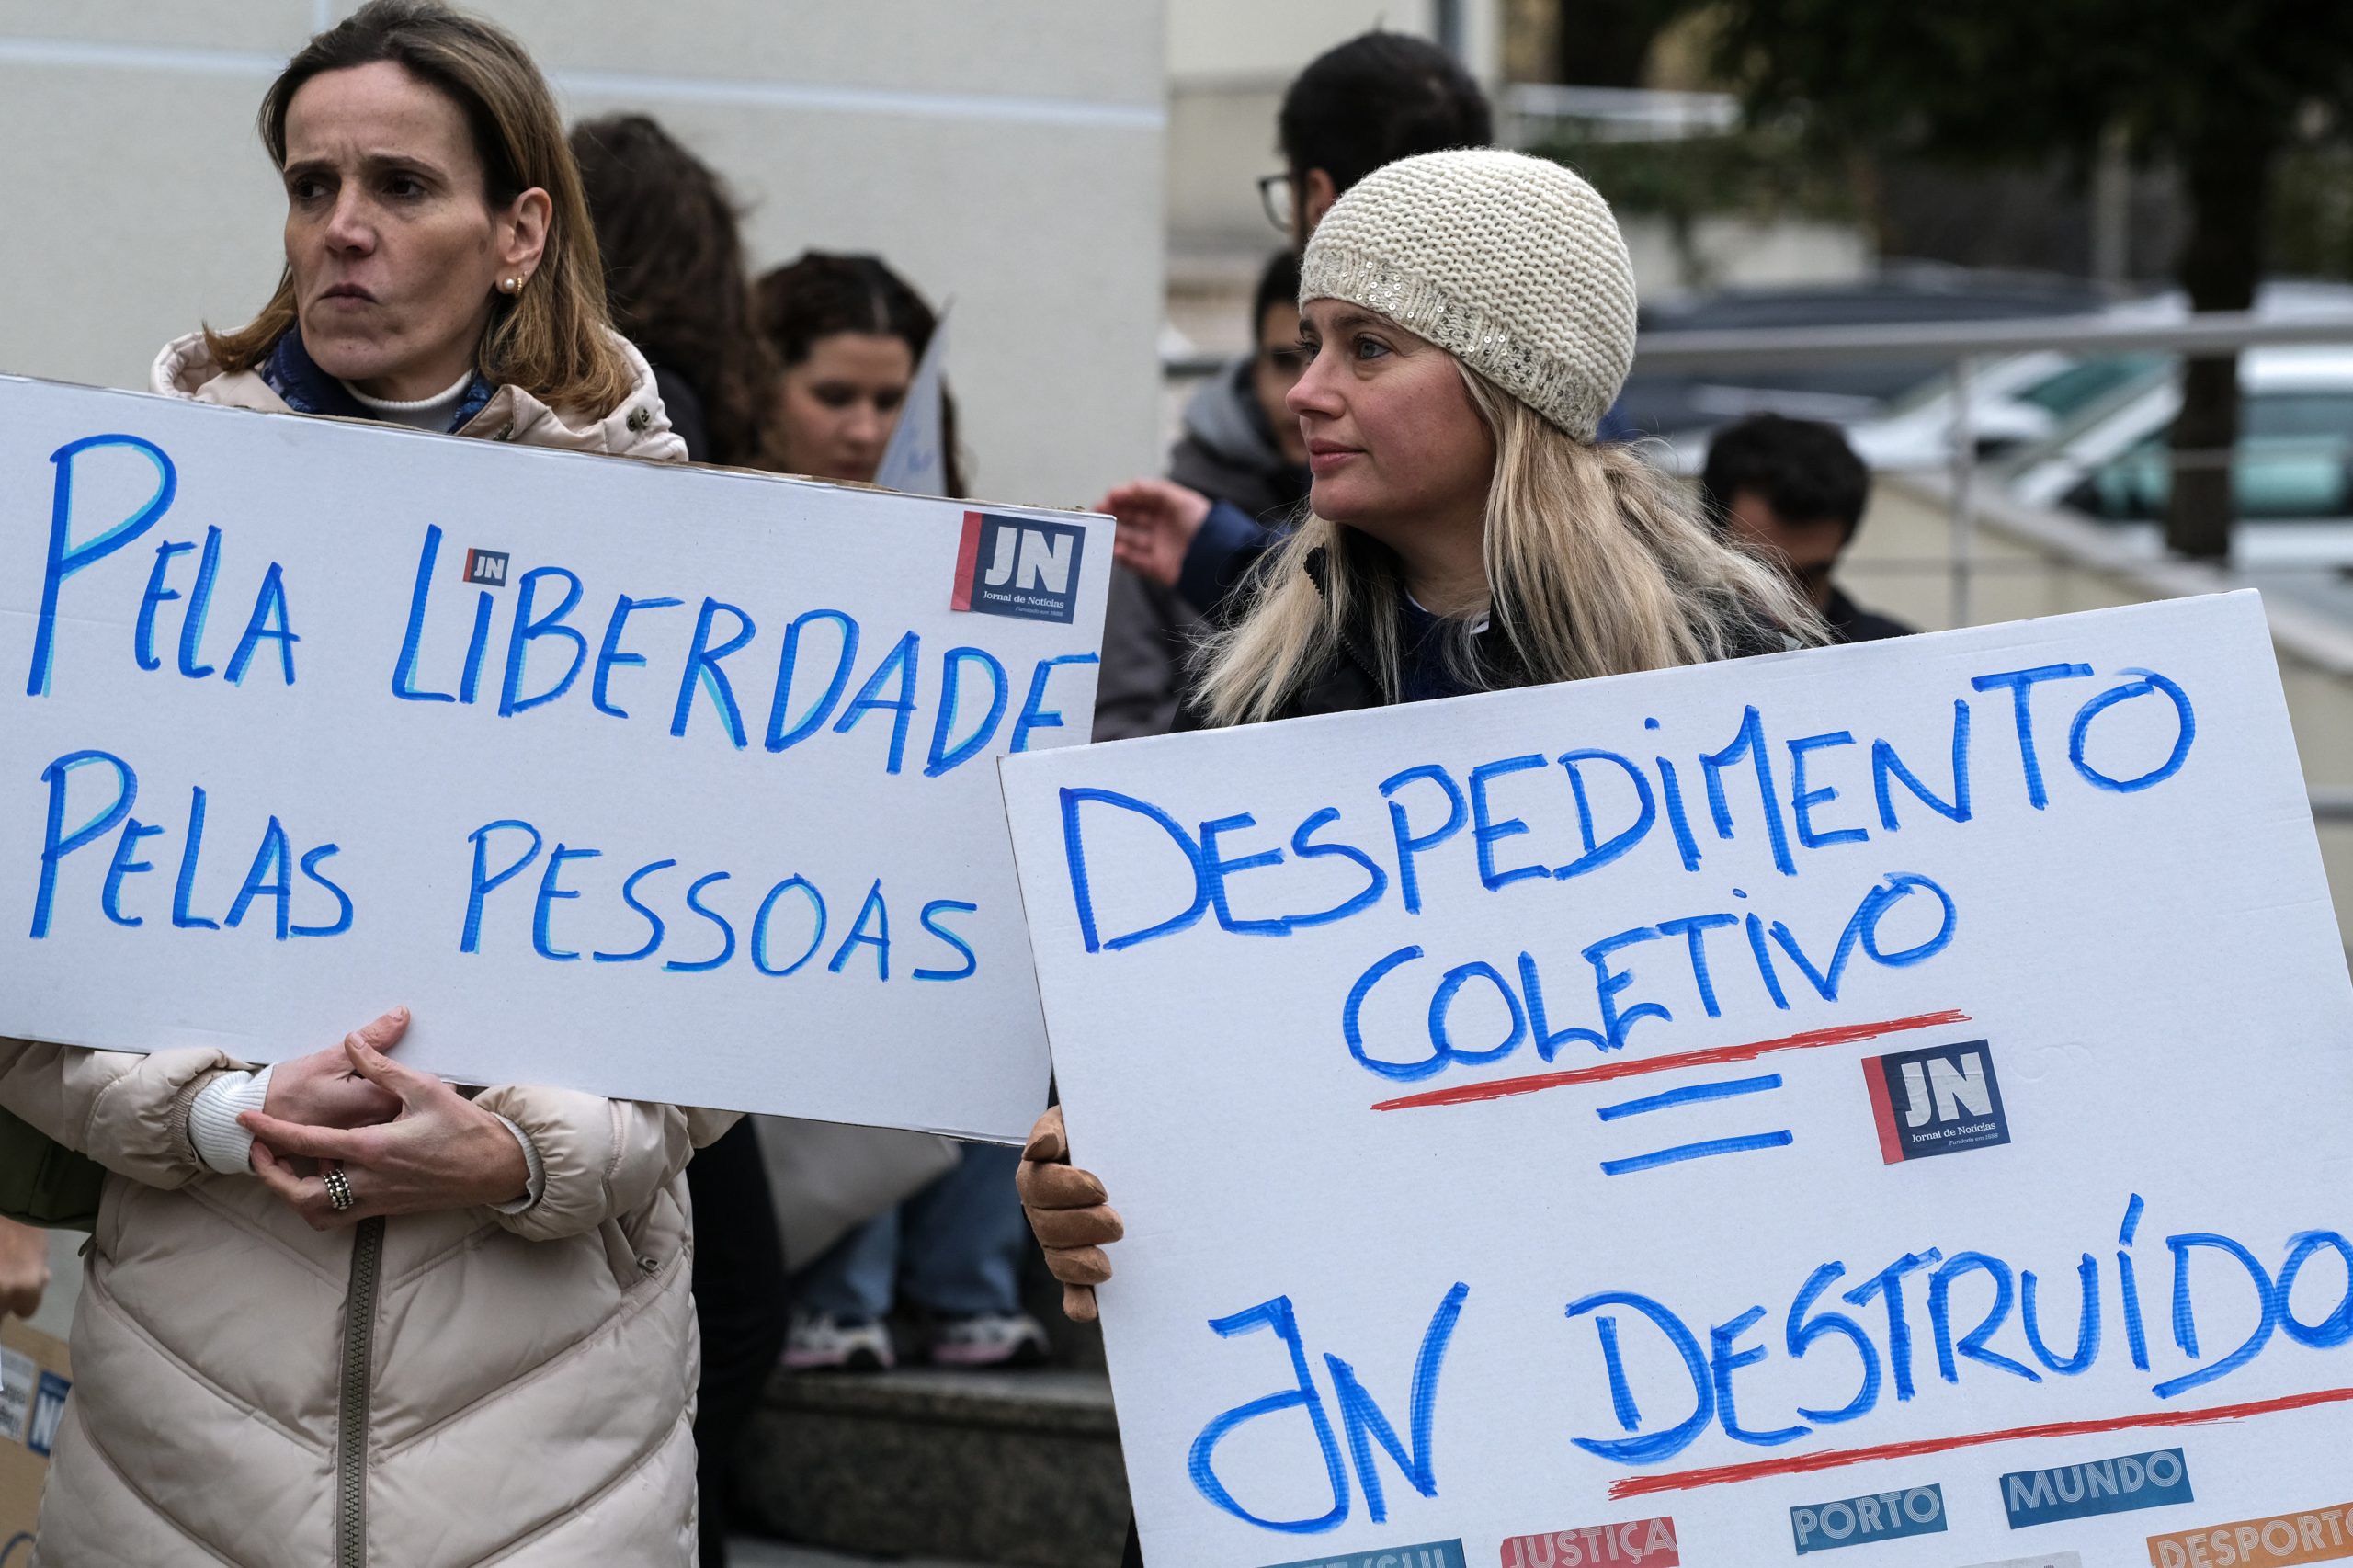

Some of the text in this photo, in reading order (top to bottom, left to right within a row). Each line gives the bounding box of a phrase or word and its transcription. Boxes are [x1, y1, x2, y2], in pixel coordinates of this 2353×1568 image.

[27, 433, 301, 698] PELA
[473, 555, 506, 580] JN
[984, 526, 1074, 594] JN
[983, 590, 1012, 603] Jornal
[1014, 595, 1026, 604] de
[29, 749, 978, 983] PELAS PESSOAS
[1900, 1051, 1994, 1128] JN
[1911, 1130, 1942, 1143] Jornal
[1943, 1128, 1956, 1138] de
[1187, 1192, 2353, 1535] JN DESTRUÍDO
[2009, 1450, 2183, 1512] MUNDO
[1509, 1517, 1678, 1568] JUSTIÇA
[1792, 1485, 1940, 1546] PORTO
[2156, 1507, 2353, 1568] DESPORT
